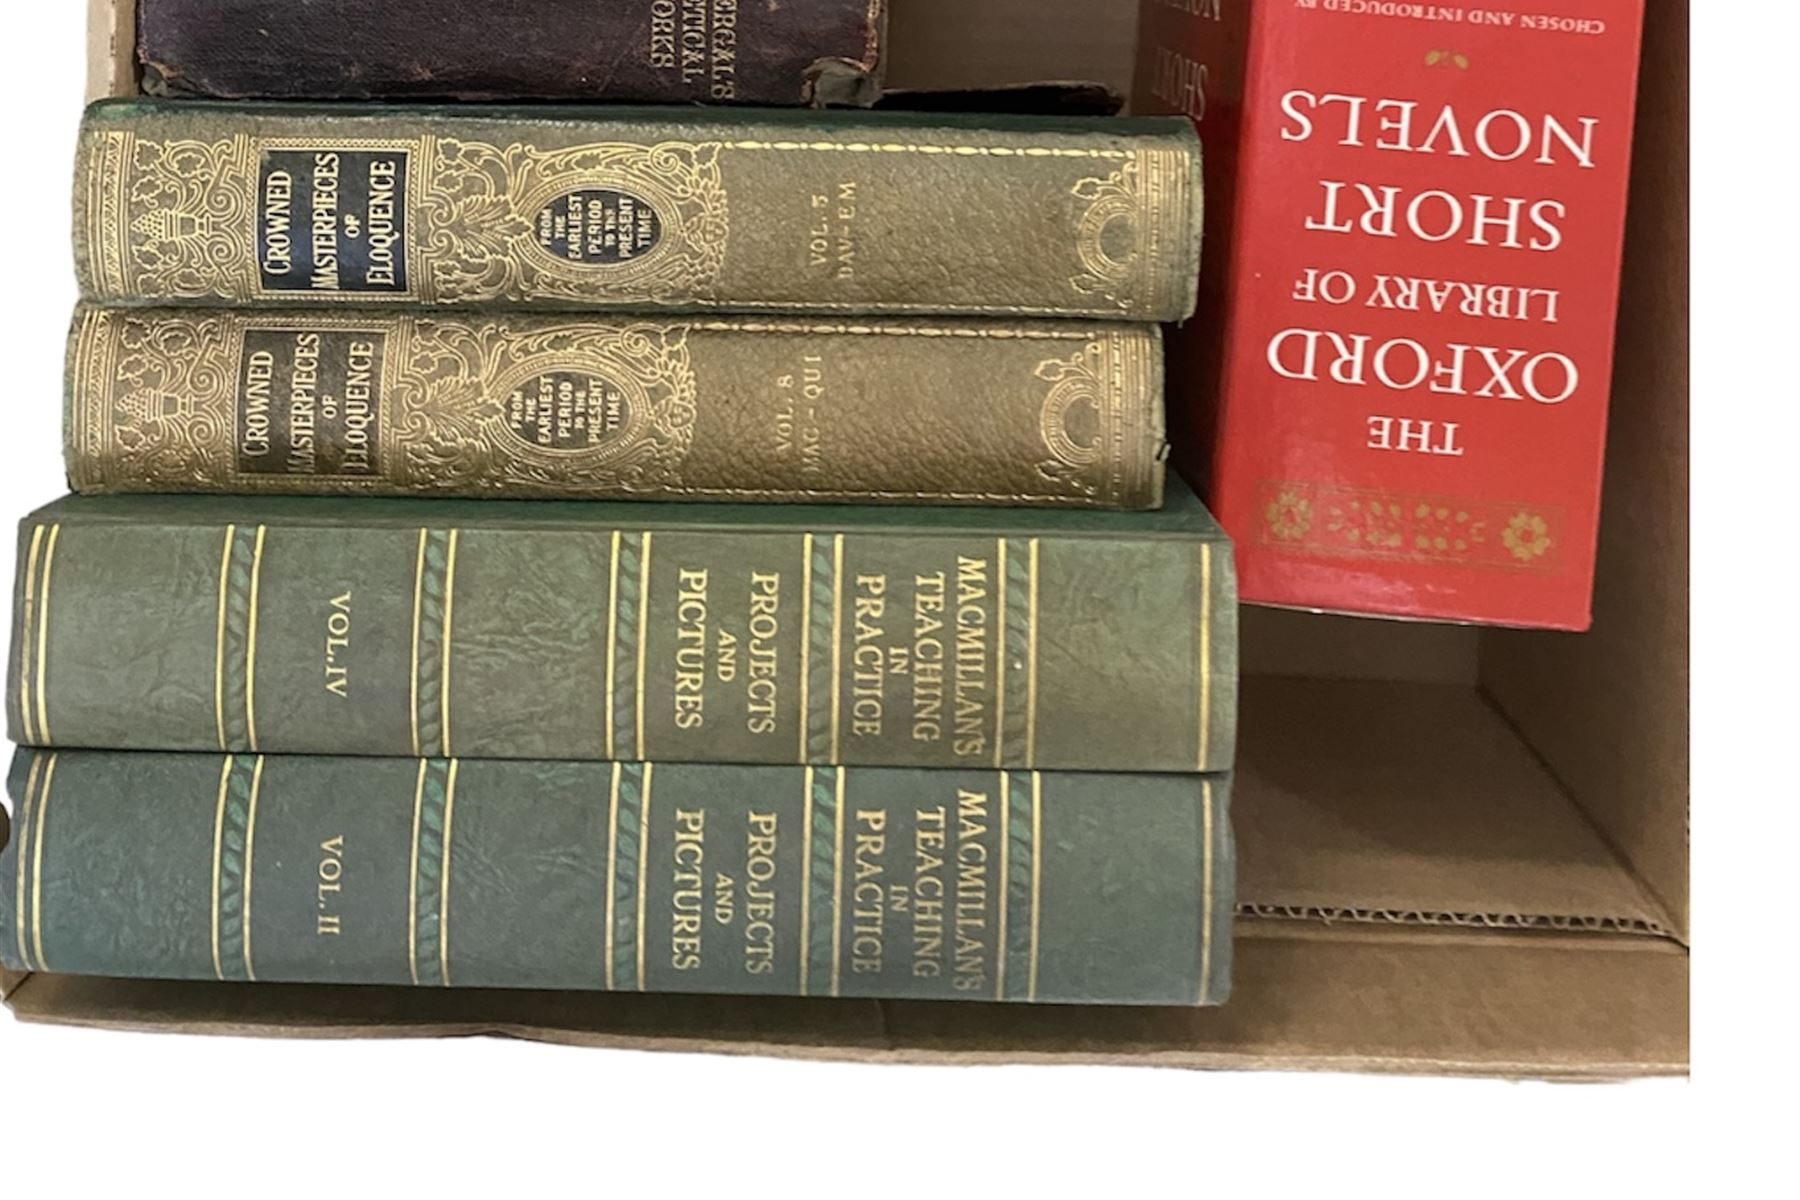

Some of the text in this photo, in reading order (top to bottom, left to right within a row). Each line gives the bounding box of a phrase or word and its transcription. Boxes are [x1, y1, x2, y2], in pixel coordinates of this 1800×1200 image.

[1469, 8, 1515, 27] AND
[1521, 14, 1605, 35] CHOSEN
[1280, 90, 1598, 167] NOVELS
[263, 170, 292, 275] CROWNED
[311, 152, 340, 290] MASTERPIECES
[344, 214, 361, 238] OF
[366, 160, 400, 286] ELOQUENCE
[540, 208, 553, 246] FROM
[554, 215, 566, 239] THE
[567, 194, 583, 259] EARLIEST
[587, 199, 603, 255] PERIOD
[618, 198, 633, 258] PRESENT
[637, 209, 652, 248] TIME
[1305, 180, 1566, 251] SHORT
[1293, 268, 1559, 323] LIBRARY OF
[777, 374, 794, 388] 8
[1267, 328, 1579, 403] OXFORD
[241, 351, 274, 457] CROWNED
[287, 333, 320, 473] MASTERPIECES
[322, 394, 338, 419] OF
[342, 341, 375, 469] ELOQUENCE
[510, 390, 523, 429] FROM
[525, 398, 537, 422] THE
[538, 376, 553, 443] EARLIEST
[558, 382, 573, 438] PERIOD
[574, 390, 586, 413] THE
[588, 378, 603, 442] PRESENT
[606, 391, 620, 432] TIME
[1367, 417, 1464, 456] THE
[674, 568, 708, 729] PICTURES
[717, 630, 737, 683] AND
[747, 571, 780, 734] PROJECTS
[853, 574, 887, 736] PRACTICE
[888, 647, 910, 675] IN
[912, 571, 945, 742] TEACHING
[952, 555, 986, 757] MACMILLAN'S
[671, 808, 705, 971] PICTURES
[715, 873, 734, 925] AND
[745, 811, 777, 975] PROJECTS
[852, 809, 887, 974] PRACTICE
[890, 885, 910, 912] IN
[912, 806, 946, 978] TEACHING
[952, 787, 988, 991] MACMILLAN'S
